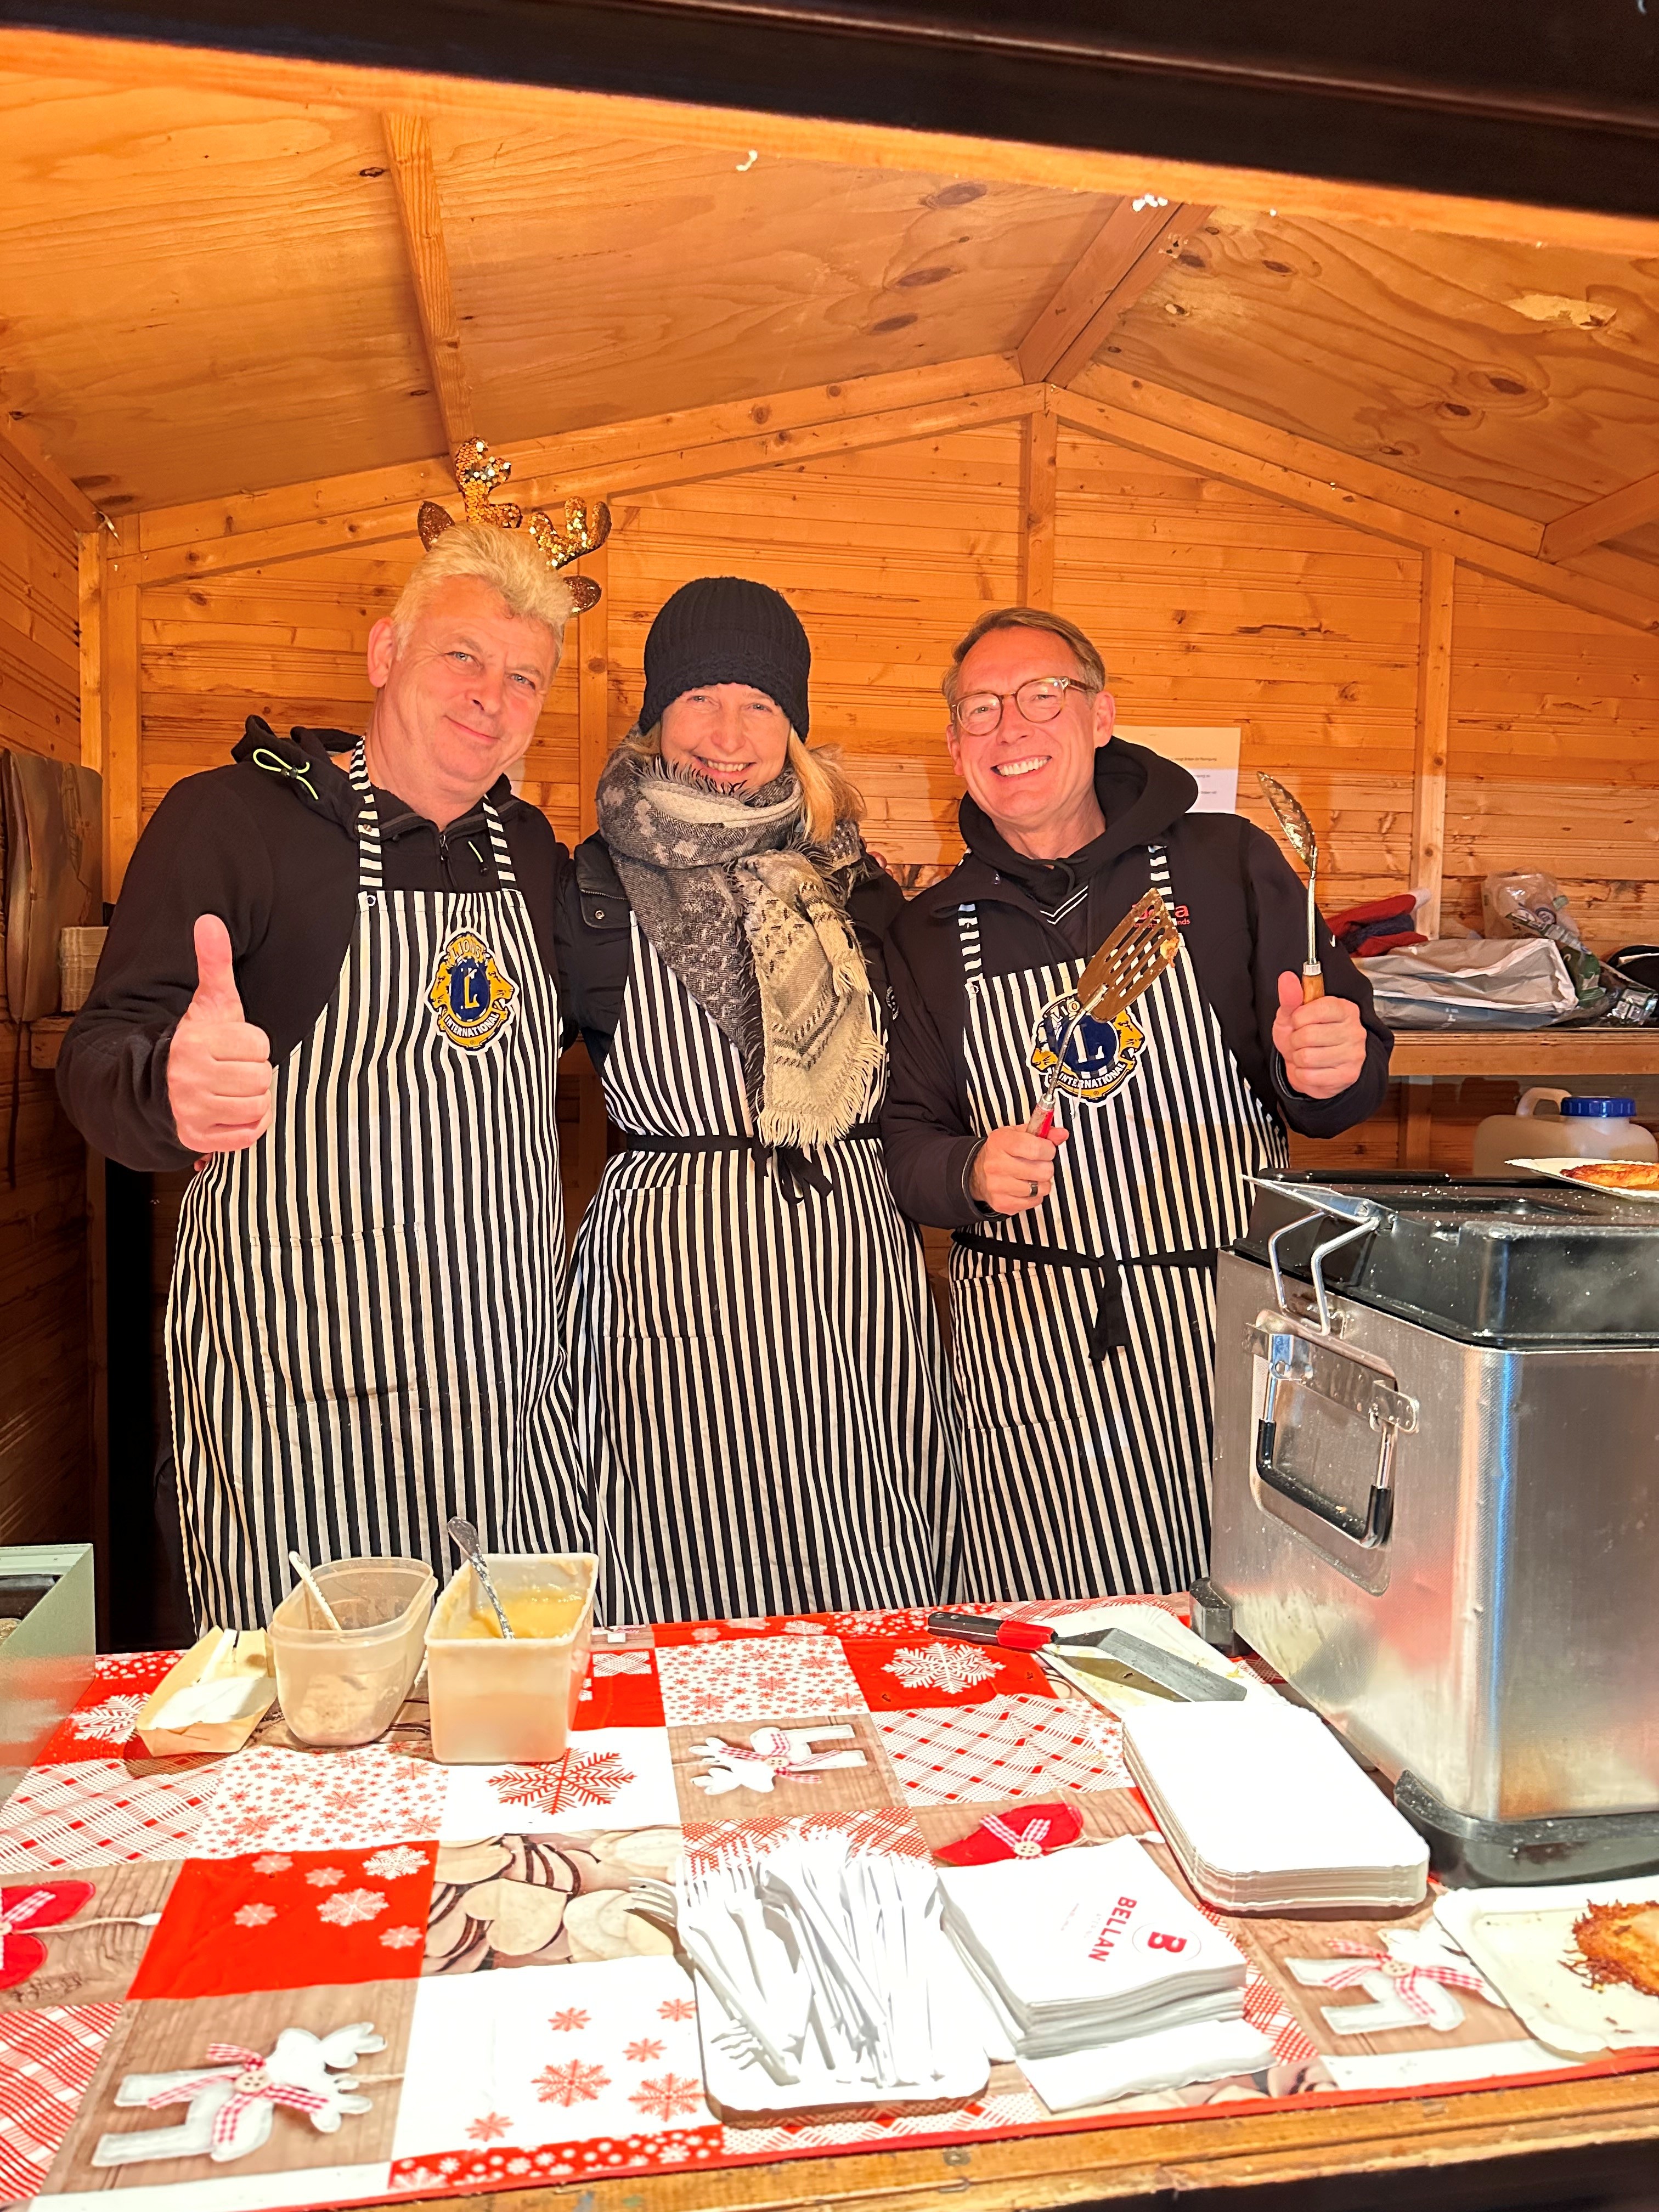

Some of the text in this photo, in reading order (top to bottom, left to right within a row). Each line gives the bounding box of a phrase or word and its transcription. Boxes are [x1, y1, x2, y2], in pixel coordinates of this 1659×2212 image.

[451, 939, 481, 960] LIONS
[460, 967, 480, 1009] L
[1050, 1000, 1081, 1023] LIO
[444, 1012, 500, 1037] INTERNATIONAL
[1072, 1023, 1105, 1063] L
[1058, 1062, 1126, 1088] INTERNATIONAL
[1088, 1896, 1137, 1962] BELLAN
[1147, 1931, 1188, 1954] B
